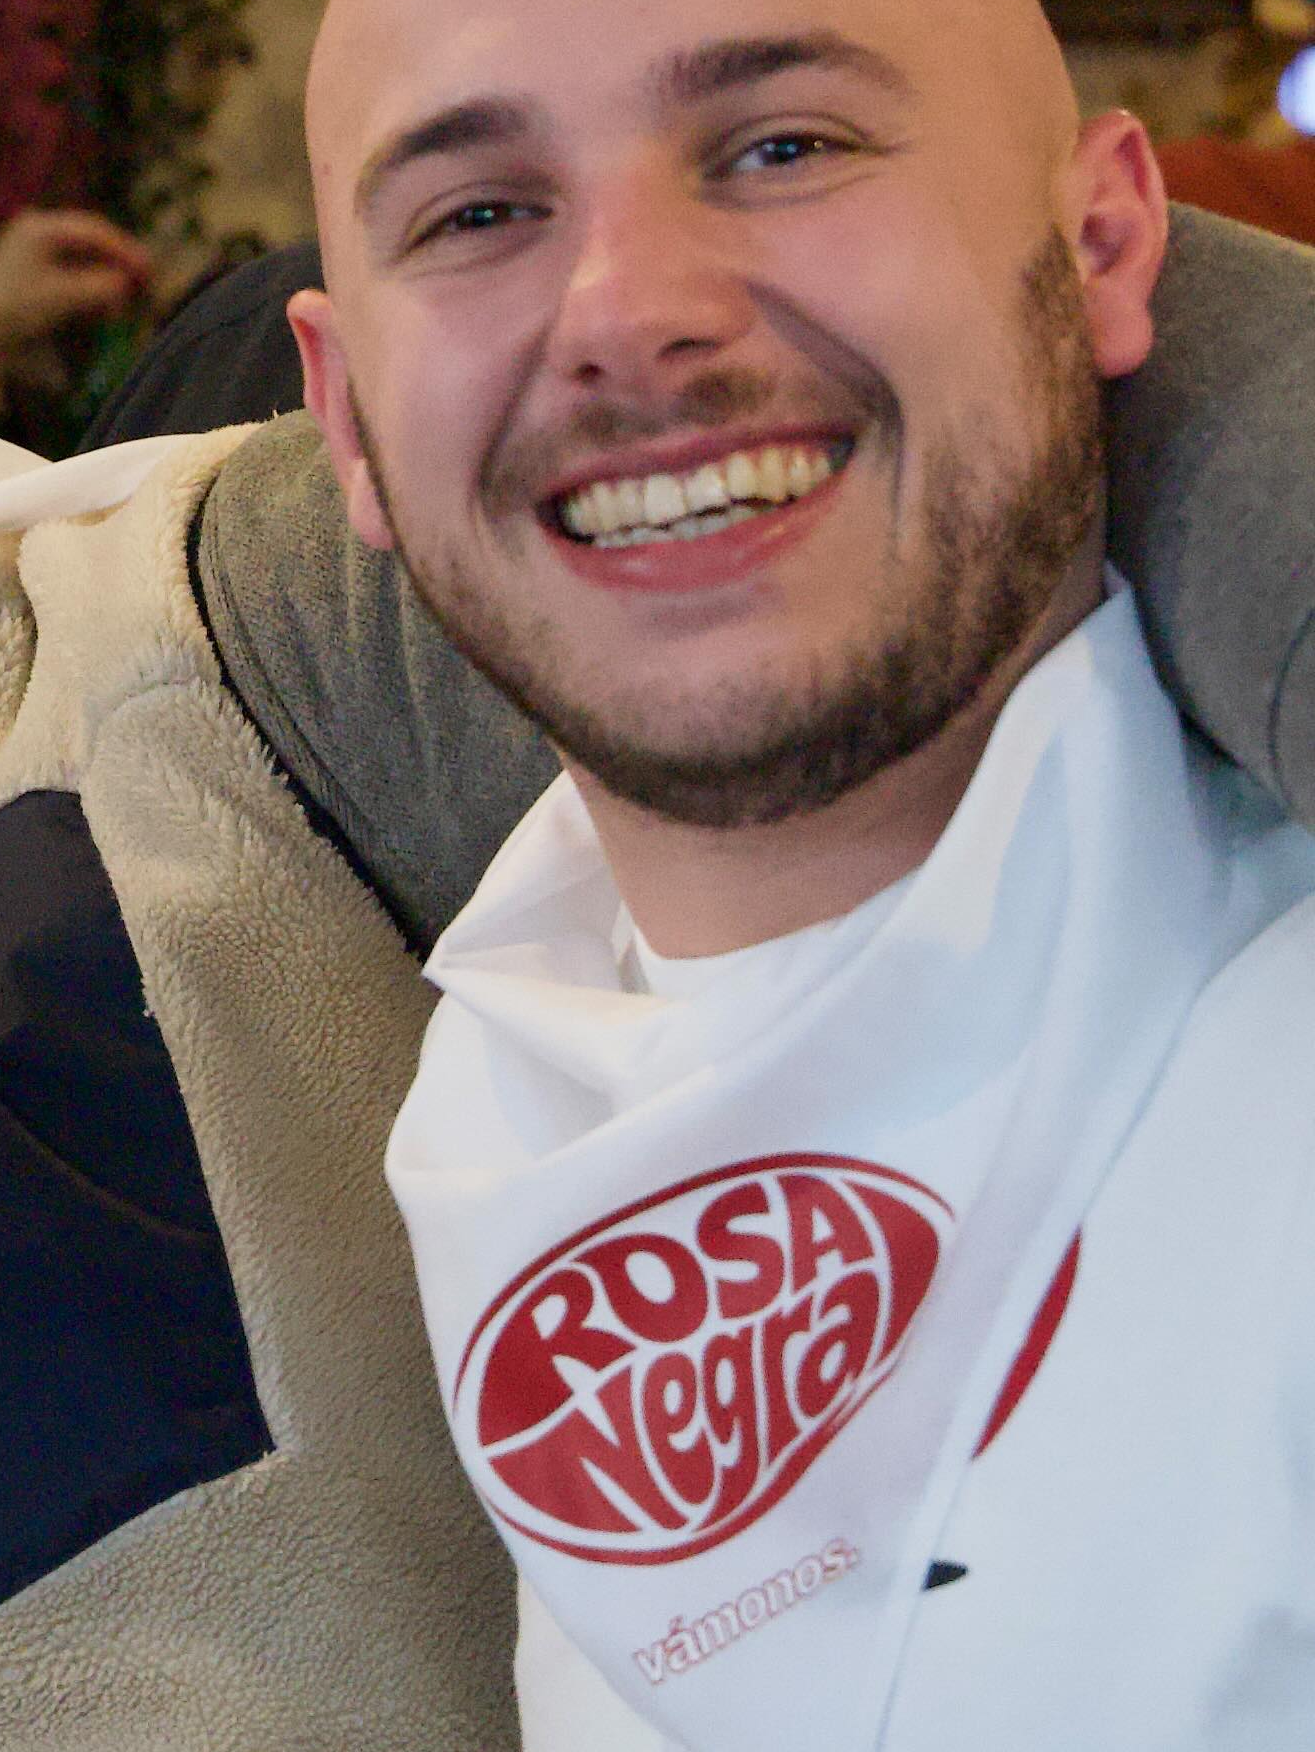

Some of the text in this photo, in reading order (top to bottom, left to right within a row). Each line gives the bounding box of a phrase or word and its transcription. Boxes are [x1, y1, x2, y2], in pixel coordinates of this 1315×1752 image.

[478, 1172, 877, 1449] ROSA
[487, 1268, 881, 1534] Negra
[632, 1536, 862, 1686] vámonos.
